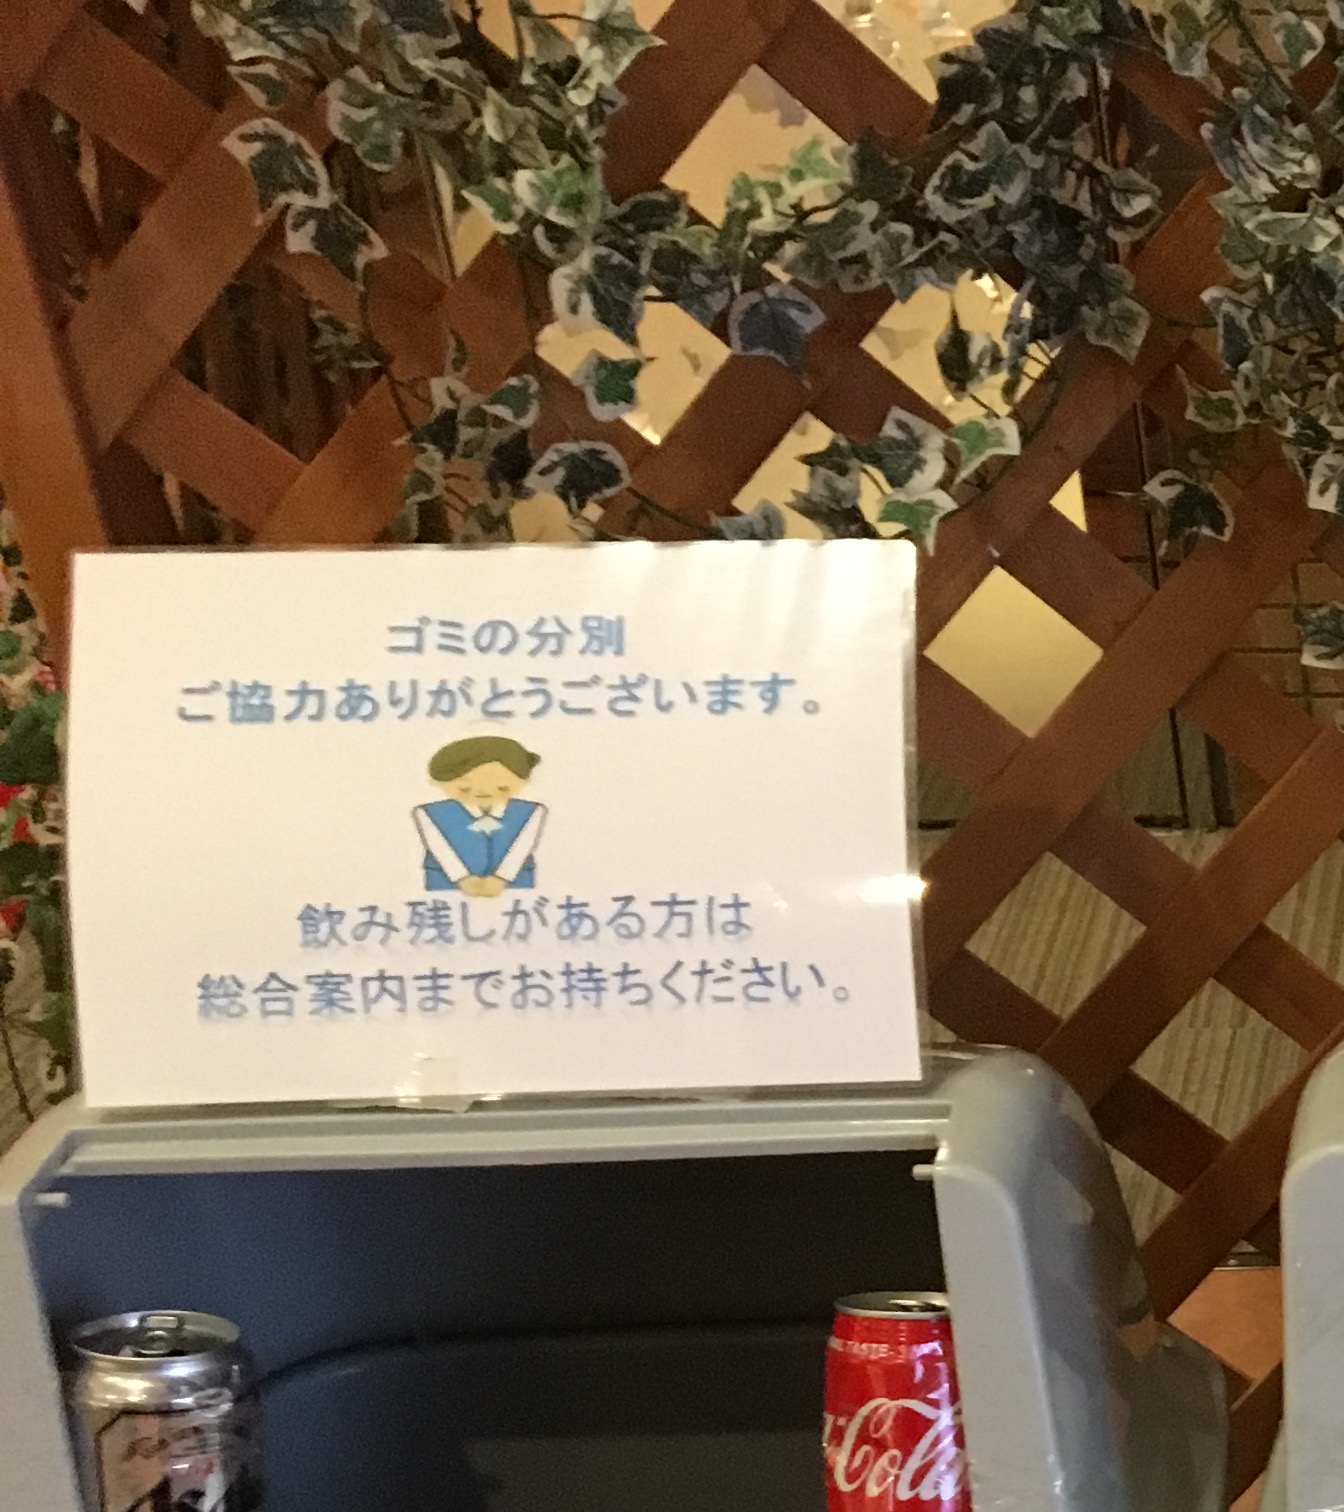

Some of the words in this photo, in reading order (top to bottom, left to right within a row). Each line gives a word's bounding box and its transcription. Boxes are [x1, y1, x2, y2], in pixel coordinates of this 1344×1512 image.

[387, 615, 628, 657] ゴミの分別
[177, 671, 824, 726] ご協力ありがとうございます。
[296, 891, 753, 949] 飲み残しがある方は
[196, 958, 853, 1020] 総合案内までお持ちください。
